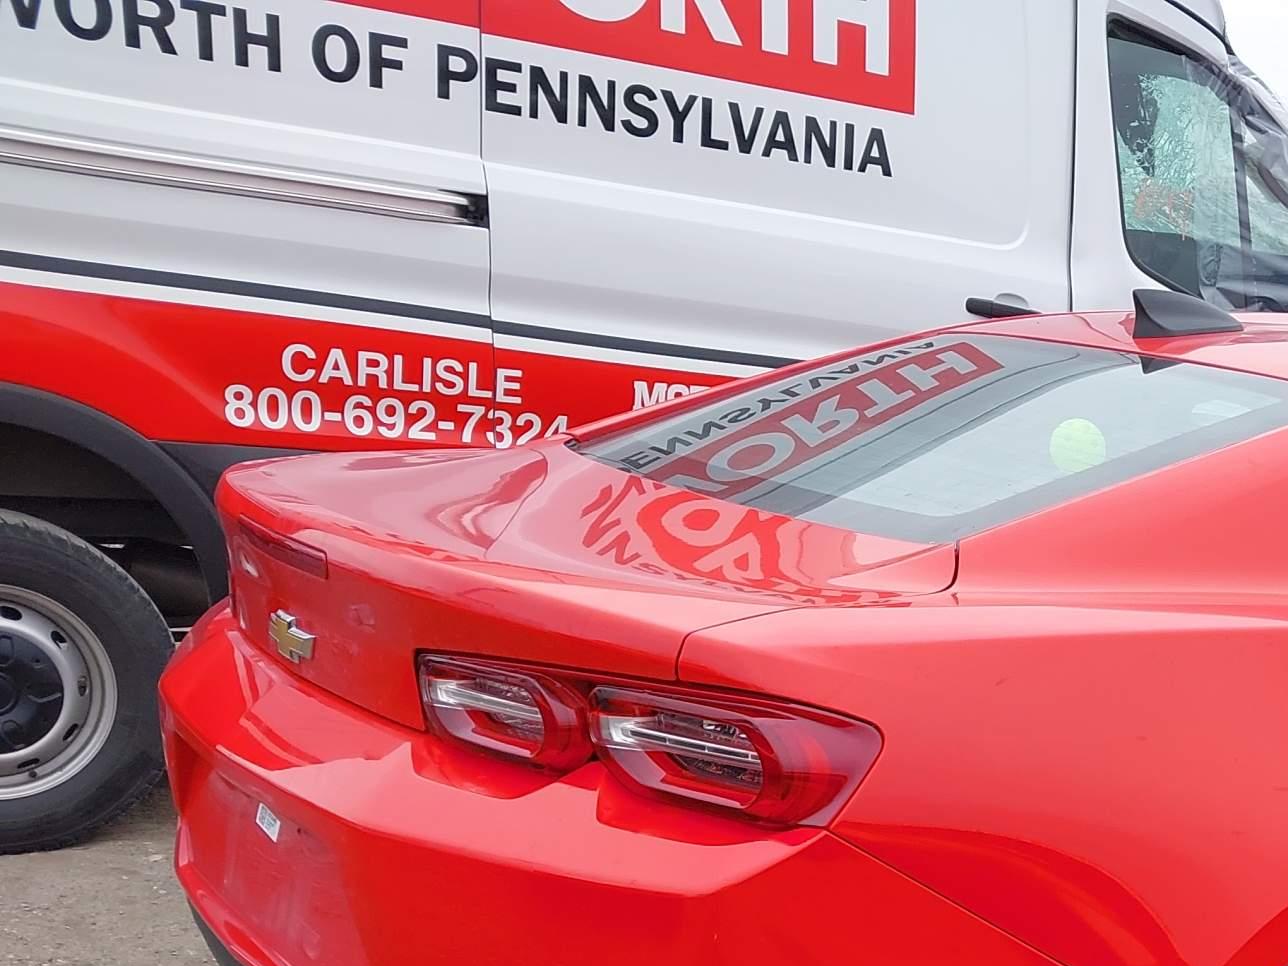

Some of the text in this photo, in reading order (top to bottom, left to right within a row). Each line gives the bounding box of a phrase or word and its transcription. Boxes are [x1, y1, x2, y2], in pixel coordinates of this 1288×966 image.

[0, 0, 893, 177] ORTH OF PENNSYLVANIA
[281, 343, 524, 404] CARLISLE
